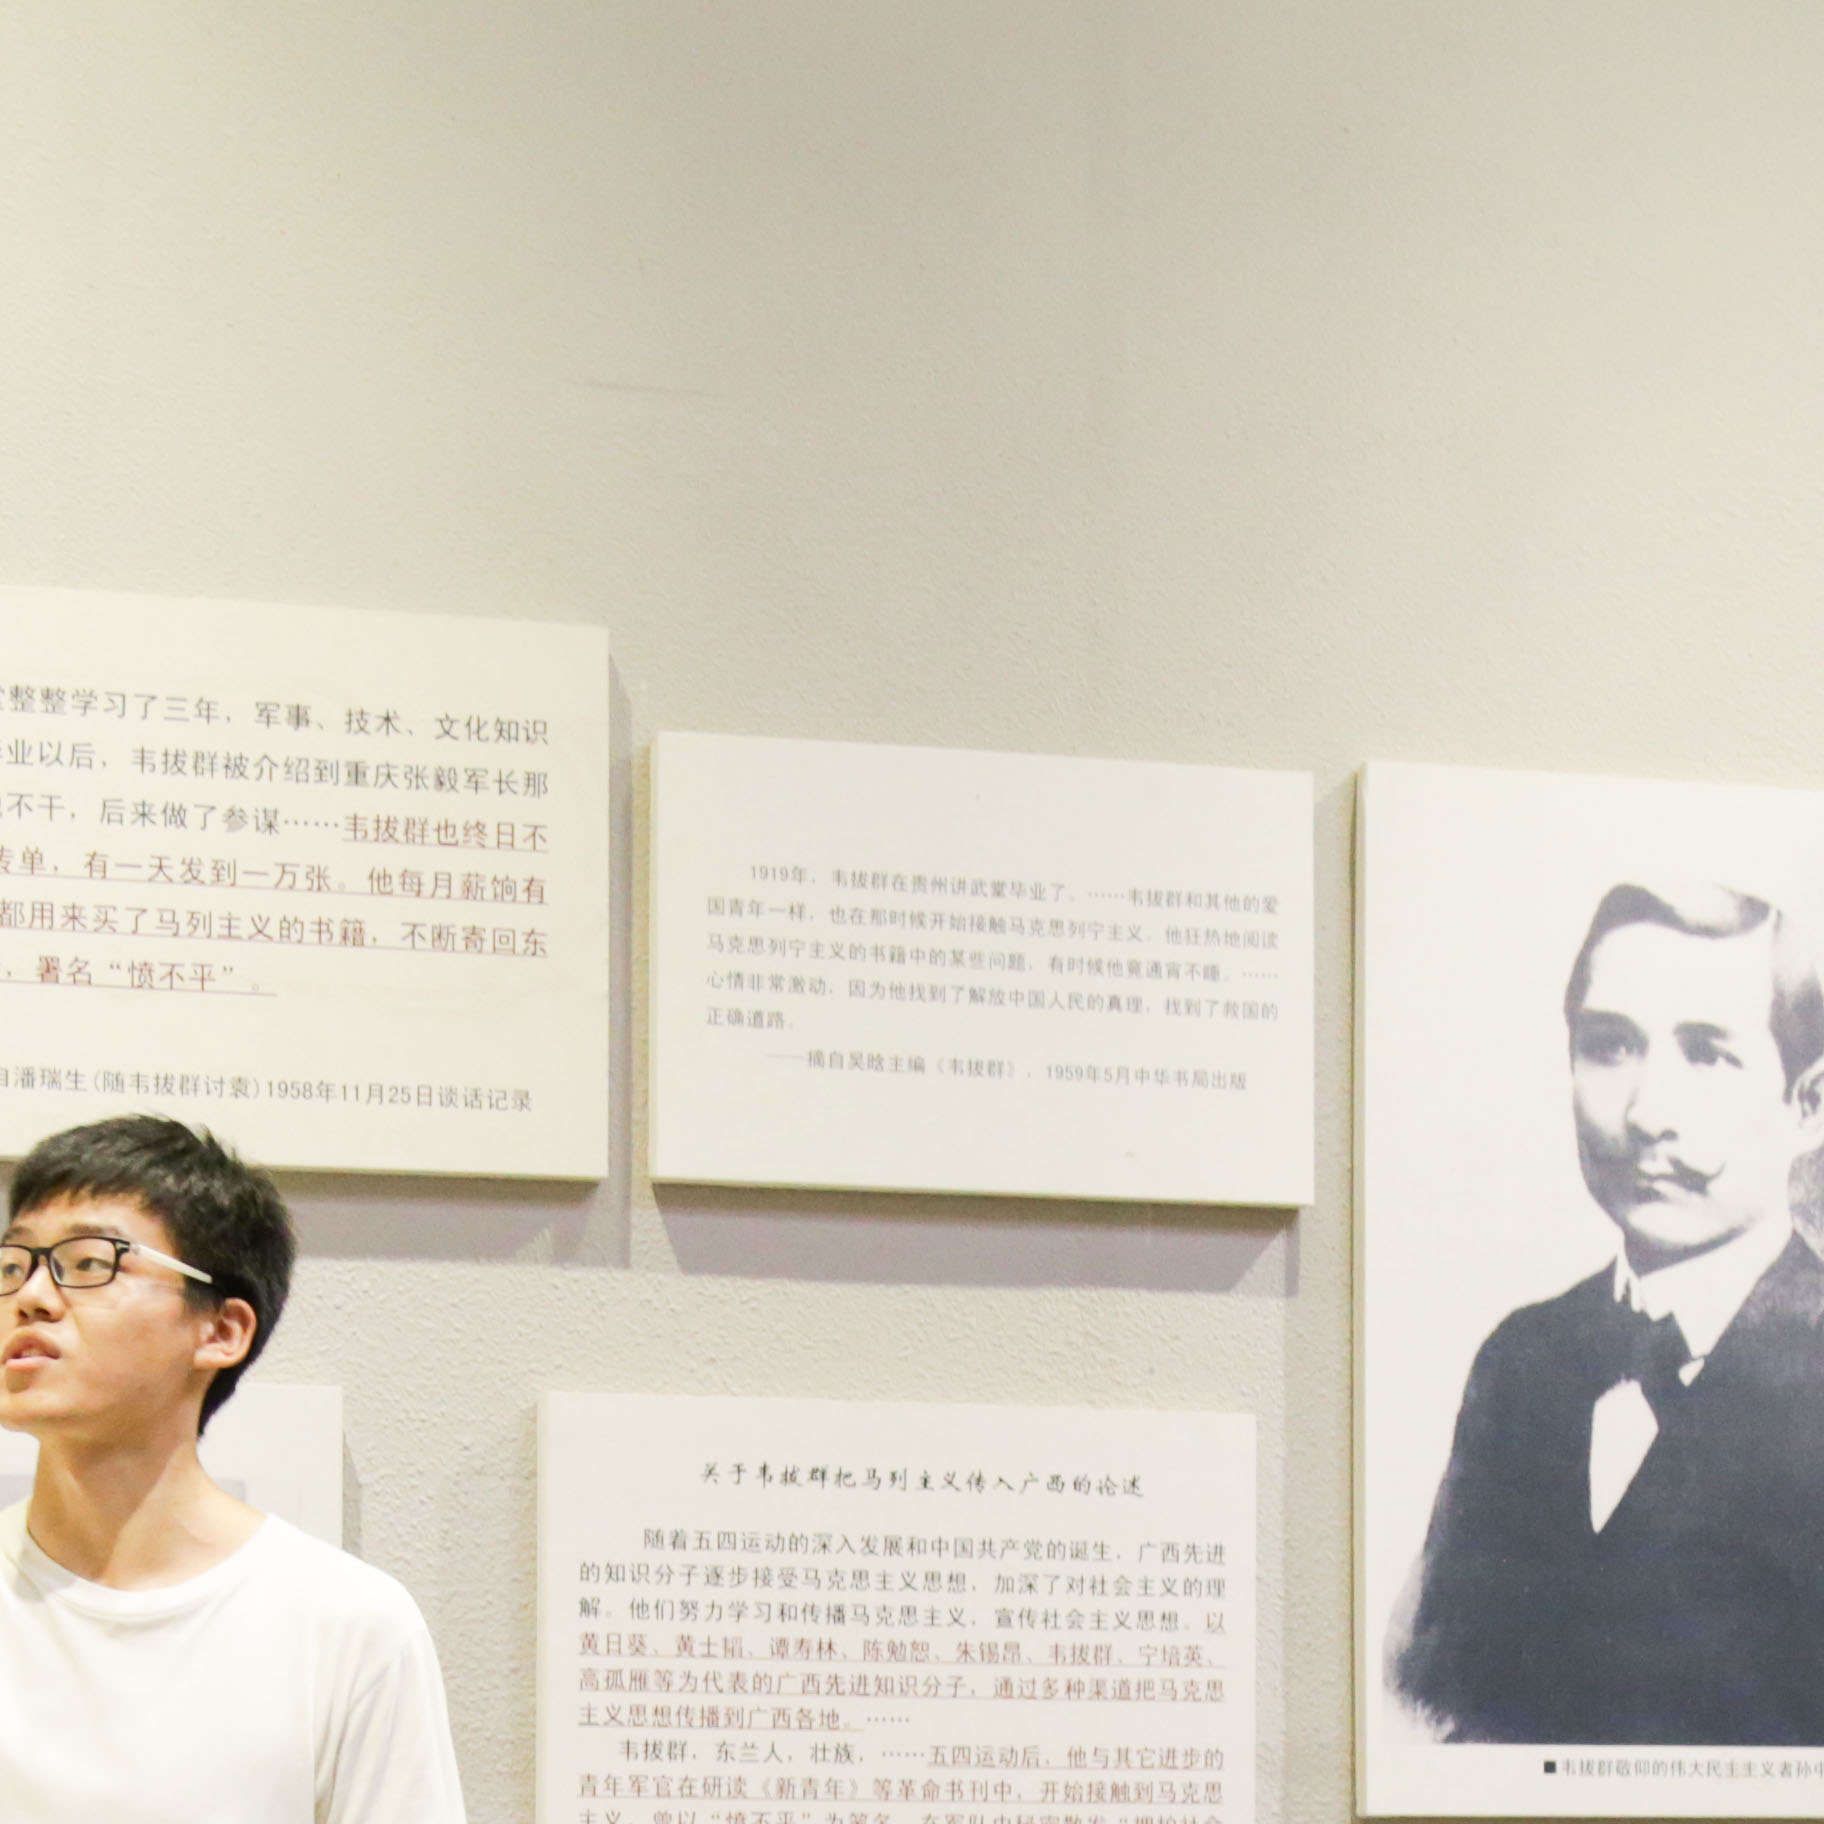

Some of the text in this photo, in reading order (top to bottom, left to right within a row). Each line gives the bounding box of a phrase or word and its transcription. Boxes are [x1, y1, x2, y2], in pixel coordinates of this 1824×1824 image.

[699, 1461, 1146, 1498] 关于韦拔群把马列主义传入广西的论述
